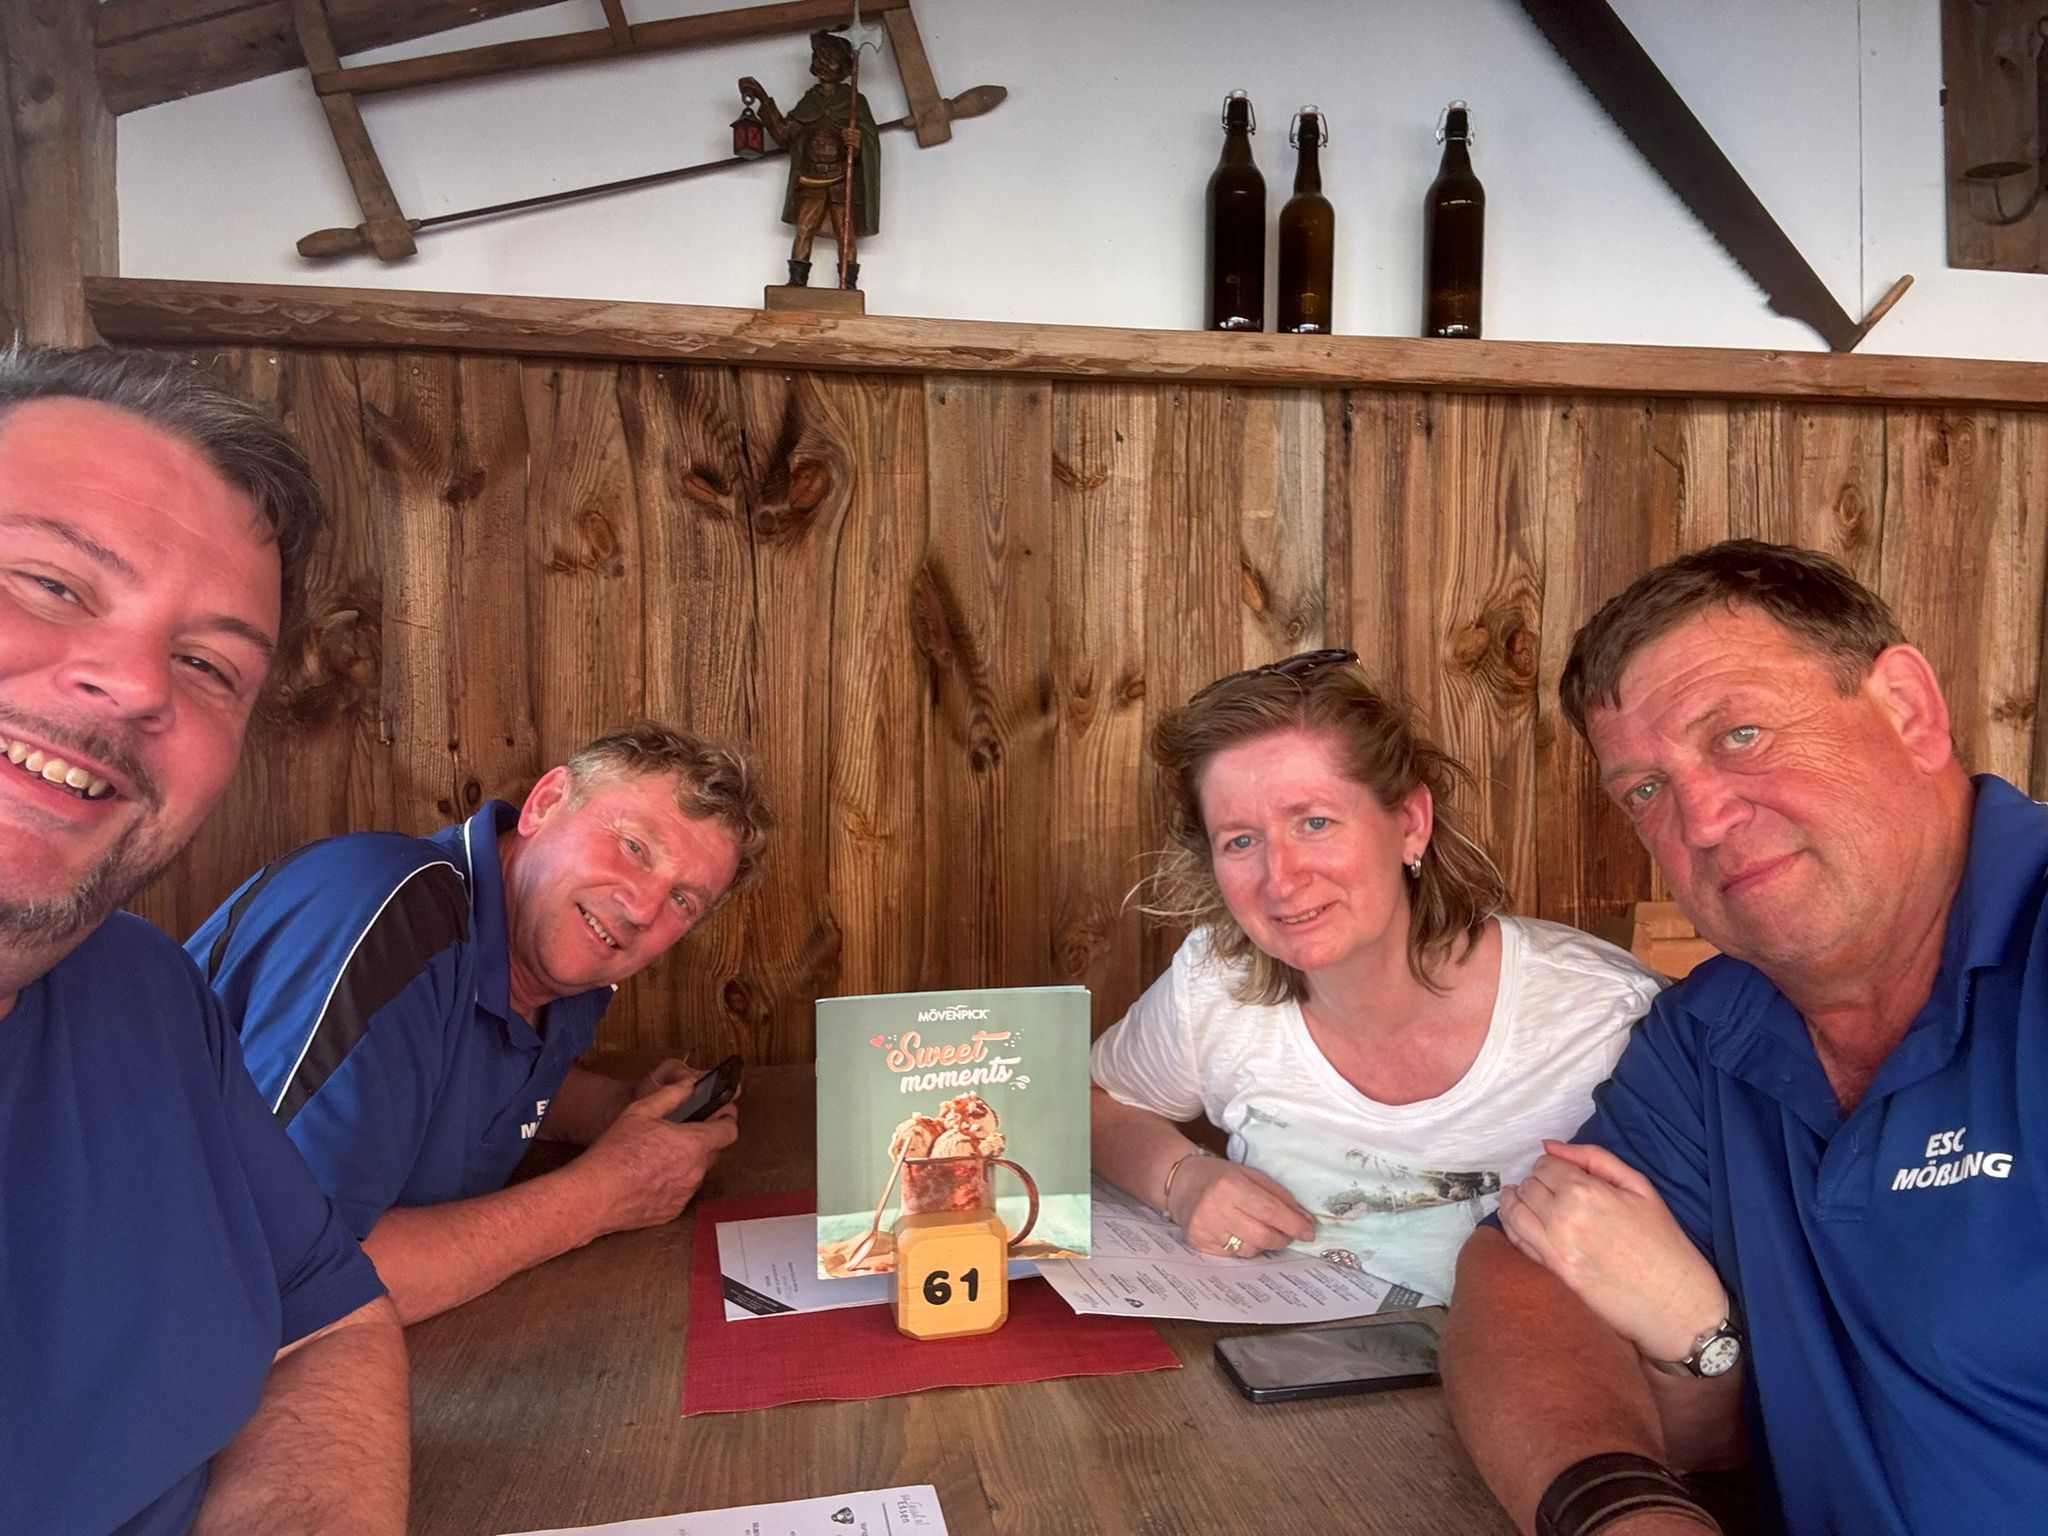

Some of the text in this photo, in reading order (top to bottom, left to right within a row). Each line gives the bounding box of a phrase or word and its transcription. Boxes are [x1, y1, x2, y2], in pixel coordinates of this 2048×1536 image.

[917, 1008, 988, 1023] MÖVENPICK
[886, 1030, 1011, 1073] Sweet
[900, 1057, 1022, 1094] moments
[536, 1098, 550, 1116] E
[521, 1117, 542, 1139] M
[1925, 1127, 1967, 1158] ESC
[923, 1268, 979, 1305] 61
